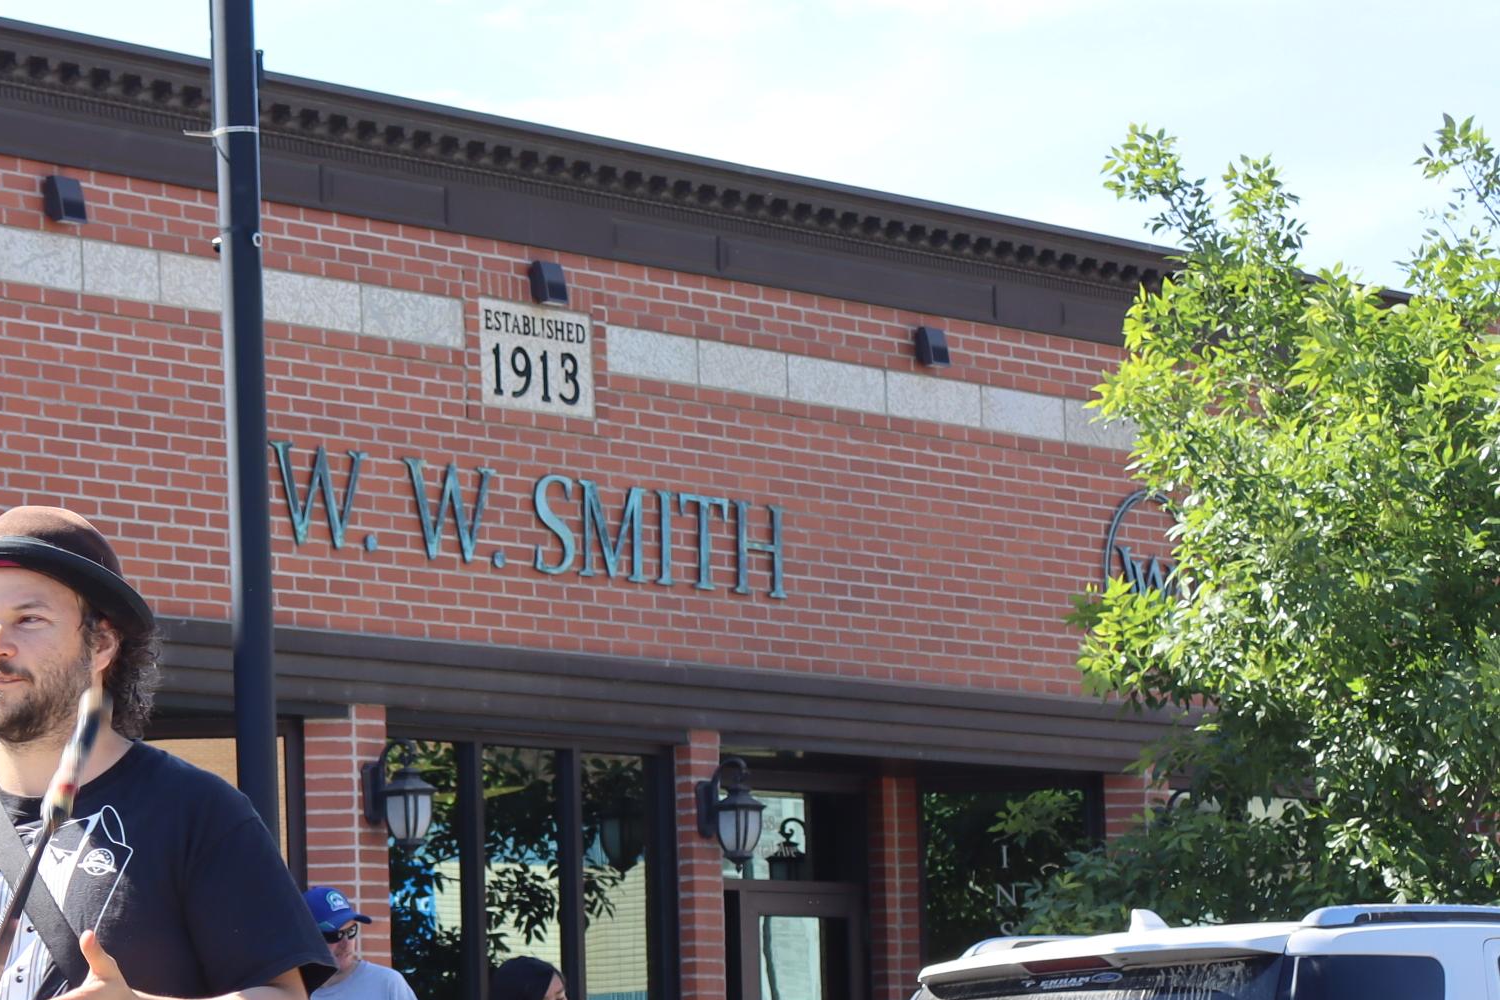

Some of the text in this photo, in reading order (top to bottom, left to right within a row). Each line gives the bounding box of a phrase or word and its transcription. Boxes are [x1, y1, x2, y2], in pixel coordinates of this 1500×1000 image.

[484, 309, 586, 344] ESTABLISHED
[492, 342, 580, 406] 1913
[270, 440, 787, 599] W. W. SMITH
